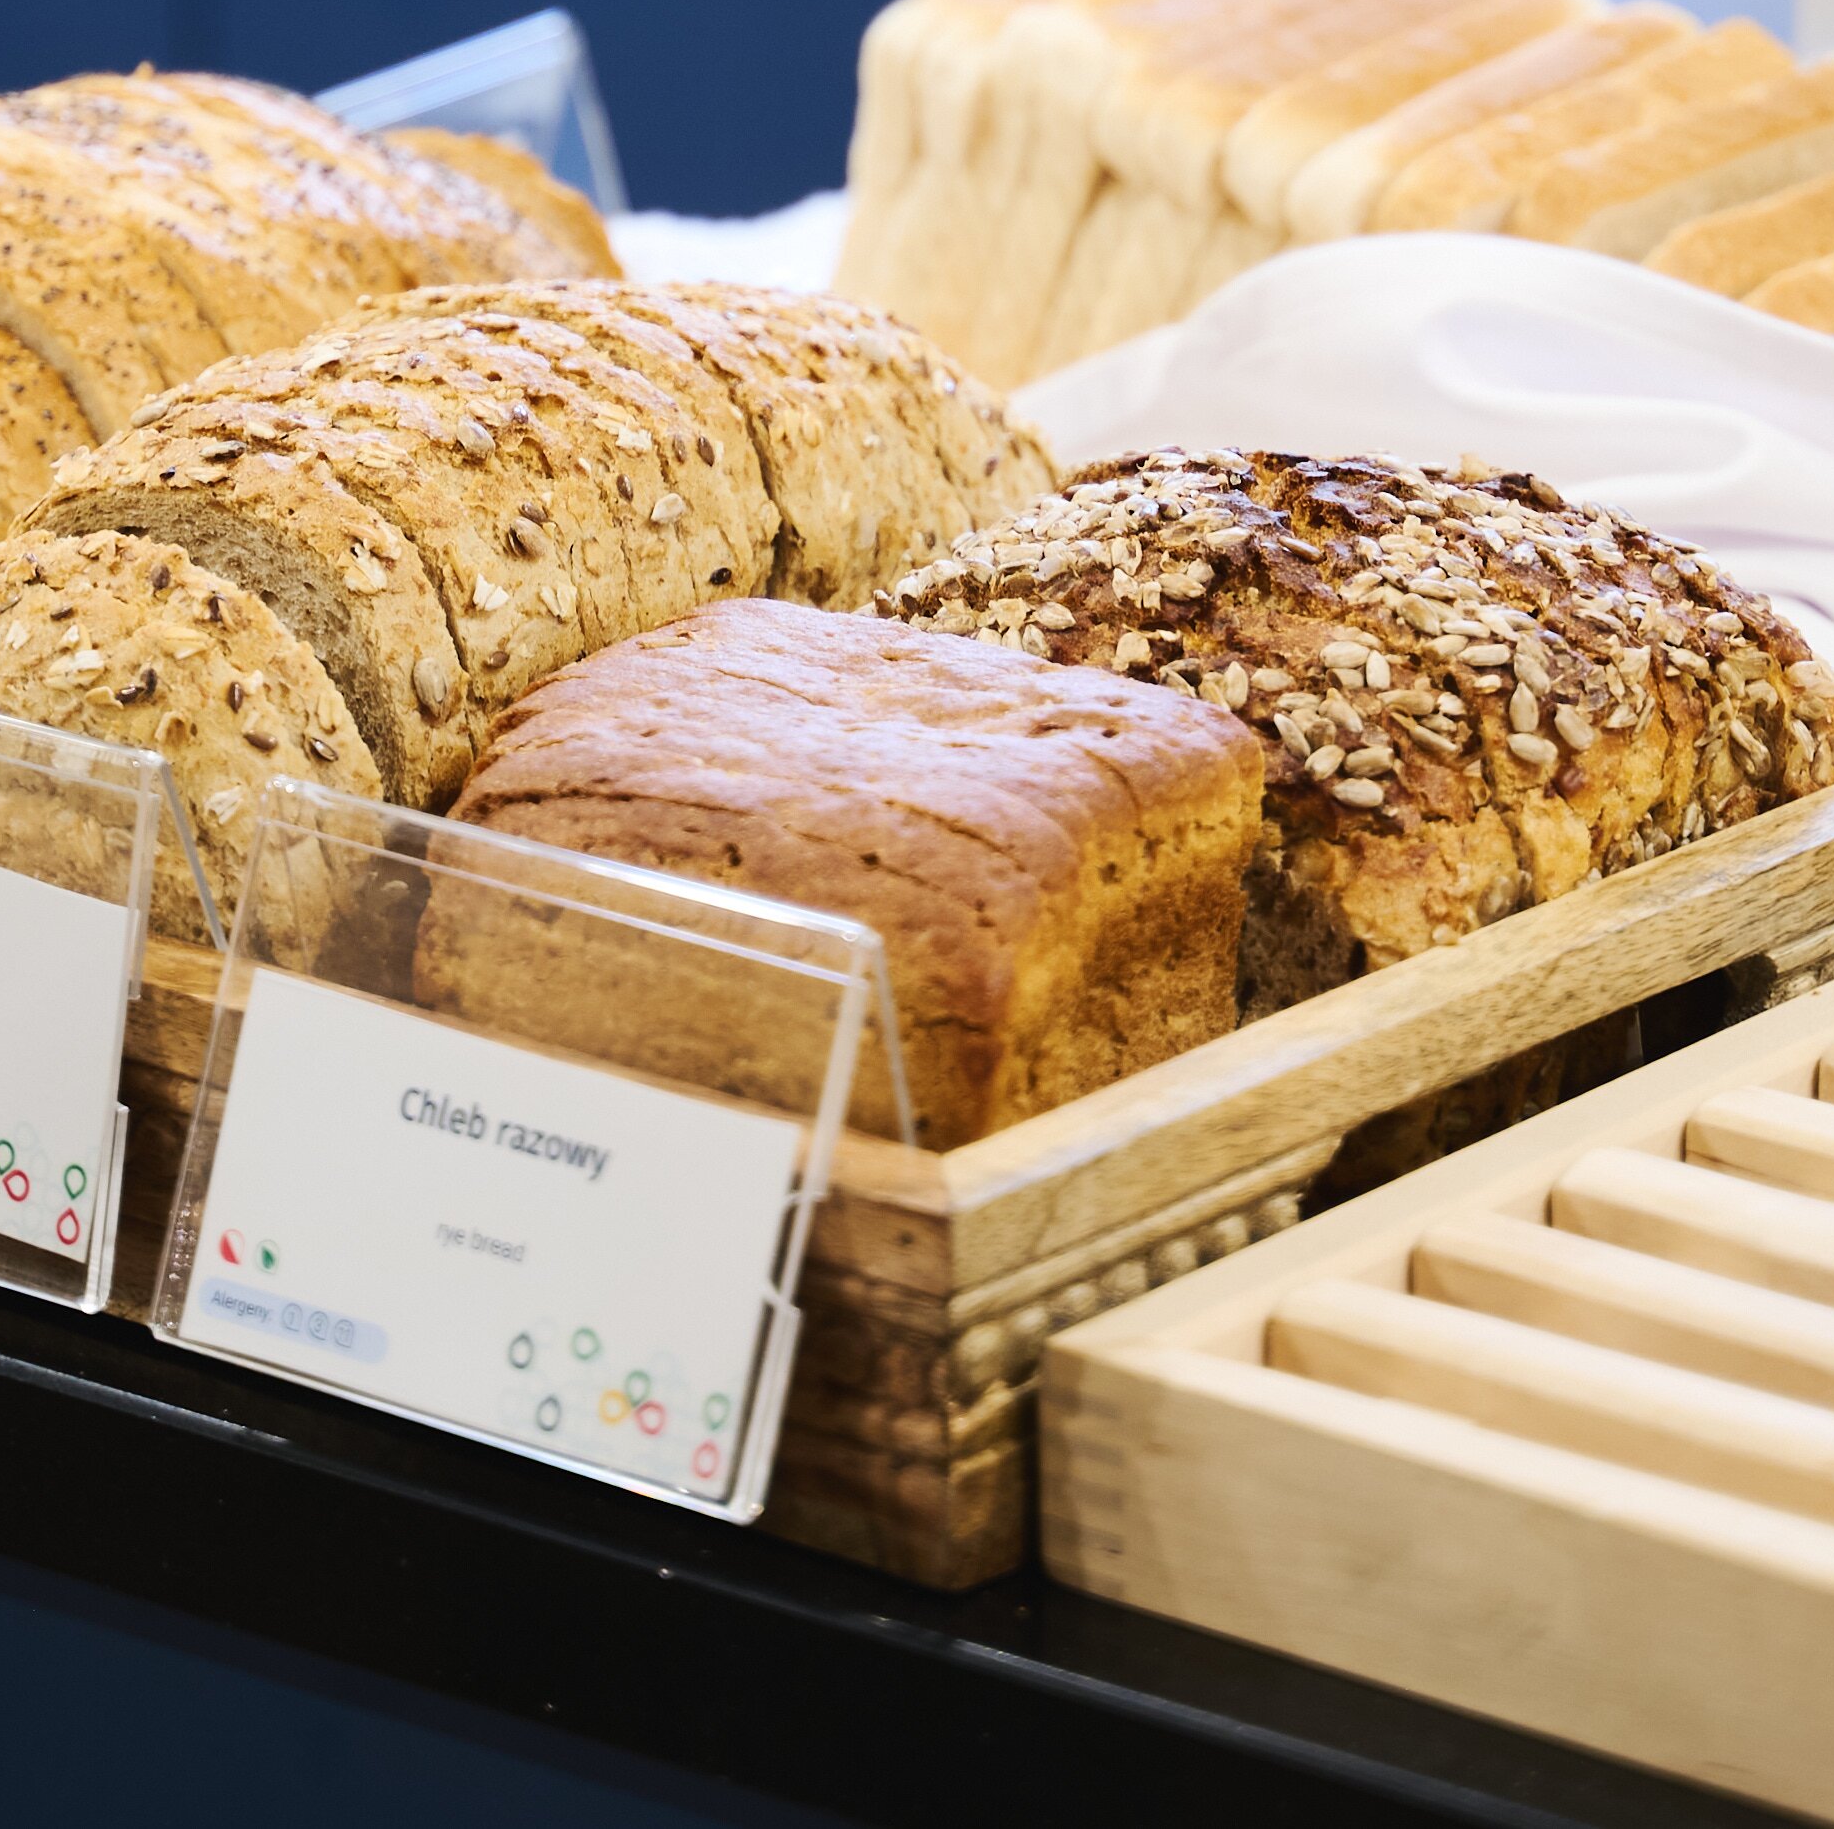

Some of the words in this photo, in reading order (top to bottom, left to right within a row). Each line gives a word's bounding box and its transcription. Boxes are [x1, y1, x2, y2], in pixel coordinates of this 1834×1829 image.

[400, 1086, 488, 1140] Chleb
[495, 1119, 611, 1182] razowy
[436, 1222, 466, 1247] rye
[469, 1227, 527, 1263] bread
